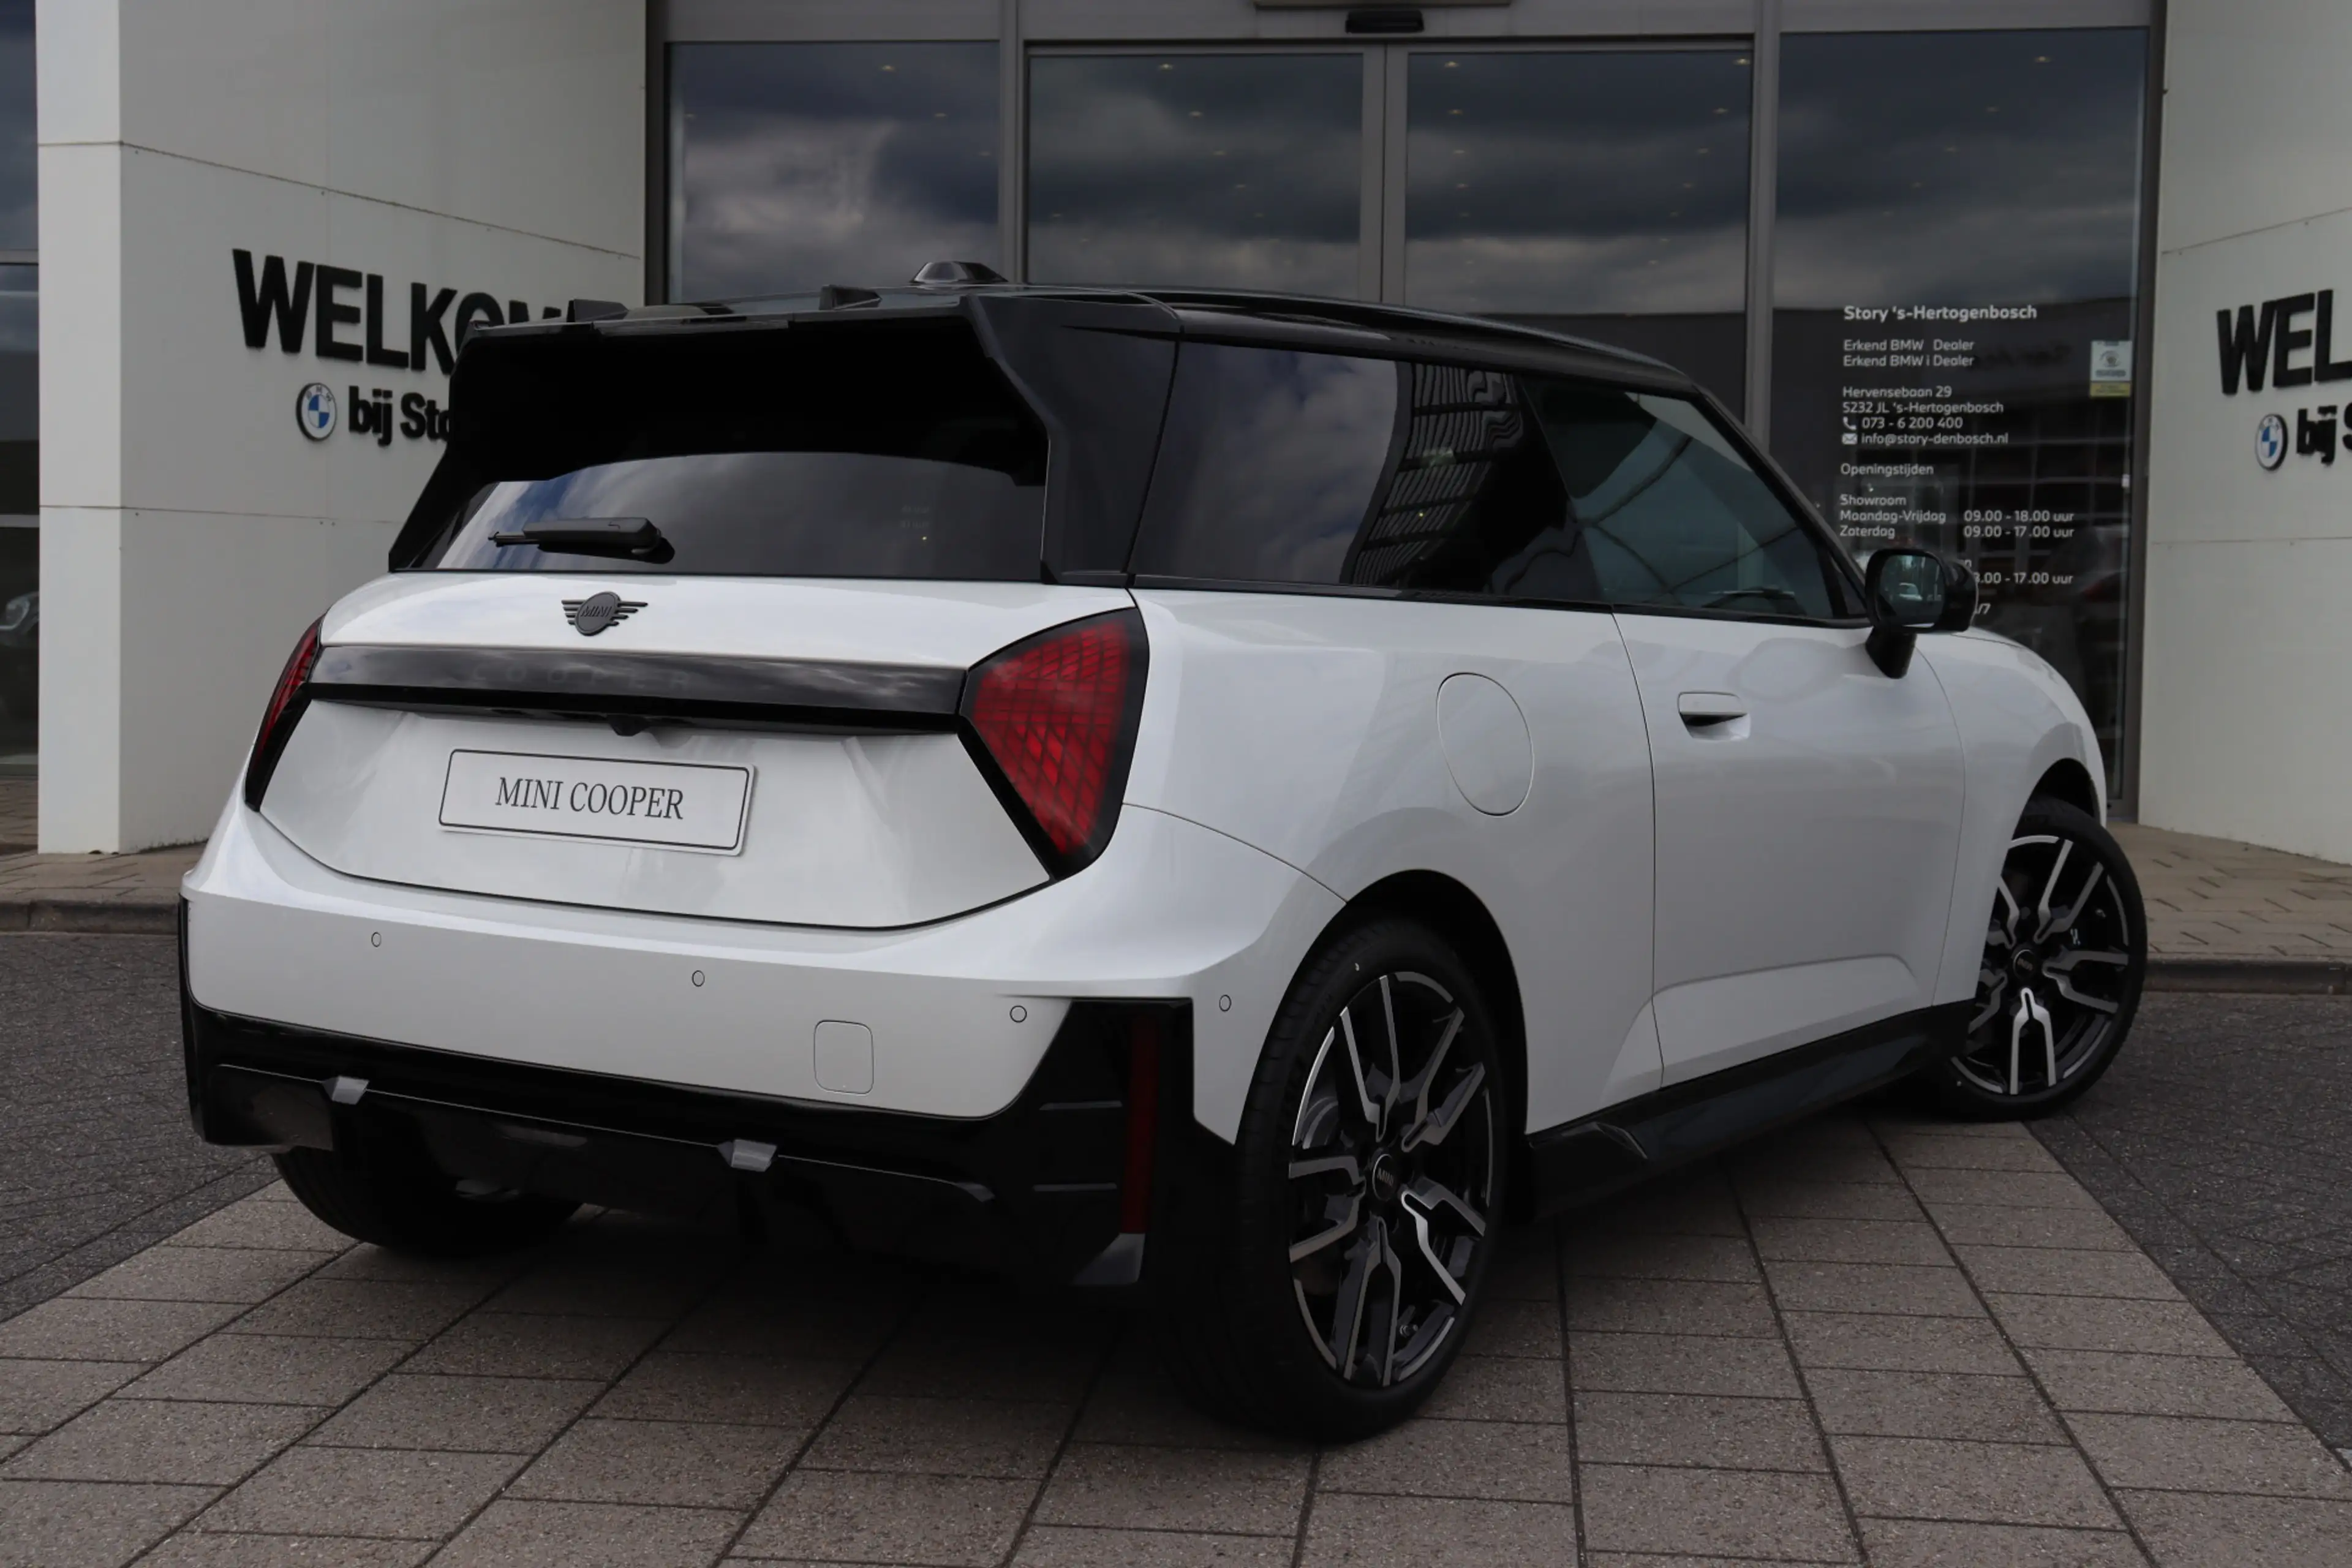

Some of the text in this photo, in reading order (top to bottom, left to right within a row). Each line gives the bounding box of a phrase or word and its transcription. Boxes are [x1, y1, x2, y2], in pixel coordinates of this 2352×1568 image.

[1844, 305, 1888, 323] Story
[1844, 339, 1975, 351] Erkend BMW Dealer
[1844, 355, 1887, 366] Erkend
[1891, 355, 1923, 366] BMW
[1933, 354, 1974, 366] Dealer
[1843, 386, 1953, 398] Hervensebaan 29
[1842, 402, 1873, 413] 5232
[1876, 402, 1890, 413] JL
[349, 385, 393, 447] bij
[1861, 417, 1885, 429] 073
[1896, 417, 1905, 429] 6
[1909, 417, 1934, 429] 200
[1937, 417, 1964, 429] 400
[1861, 432, 2009, 446] info@story-denbosch.nl
[2296, 404, 2337, 466] bij
[1841, 463, 1934, 477] Openingstijden
[1839, 494, 1907, 506] Showroom
[1839, 510, 1947, 524] Maandag-Vrijdag
[1964, 510, 2002, 522] 09.00
[2015, 510, 2051, 522] 18.00
[2052, 513, 2075, 522] uur
[1839, 525, 1896, 539] Zaterdag
[1964, 526, 2002, 538] 09.00
[2014, 526, 2051, 538] 17.00
[2052, 529, 2075, 538] uur
[2013, 572, 2049, 584] 17.00
[2052, 576, 2074, 584] uur
[581, 605, 612, 617] MINI
[495, 777, 684, 820] MINI COOPER
